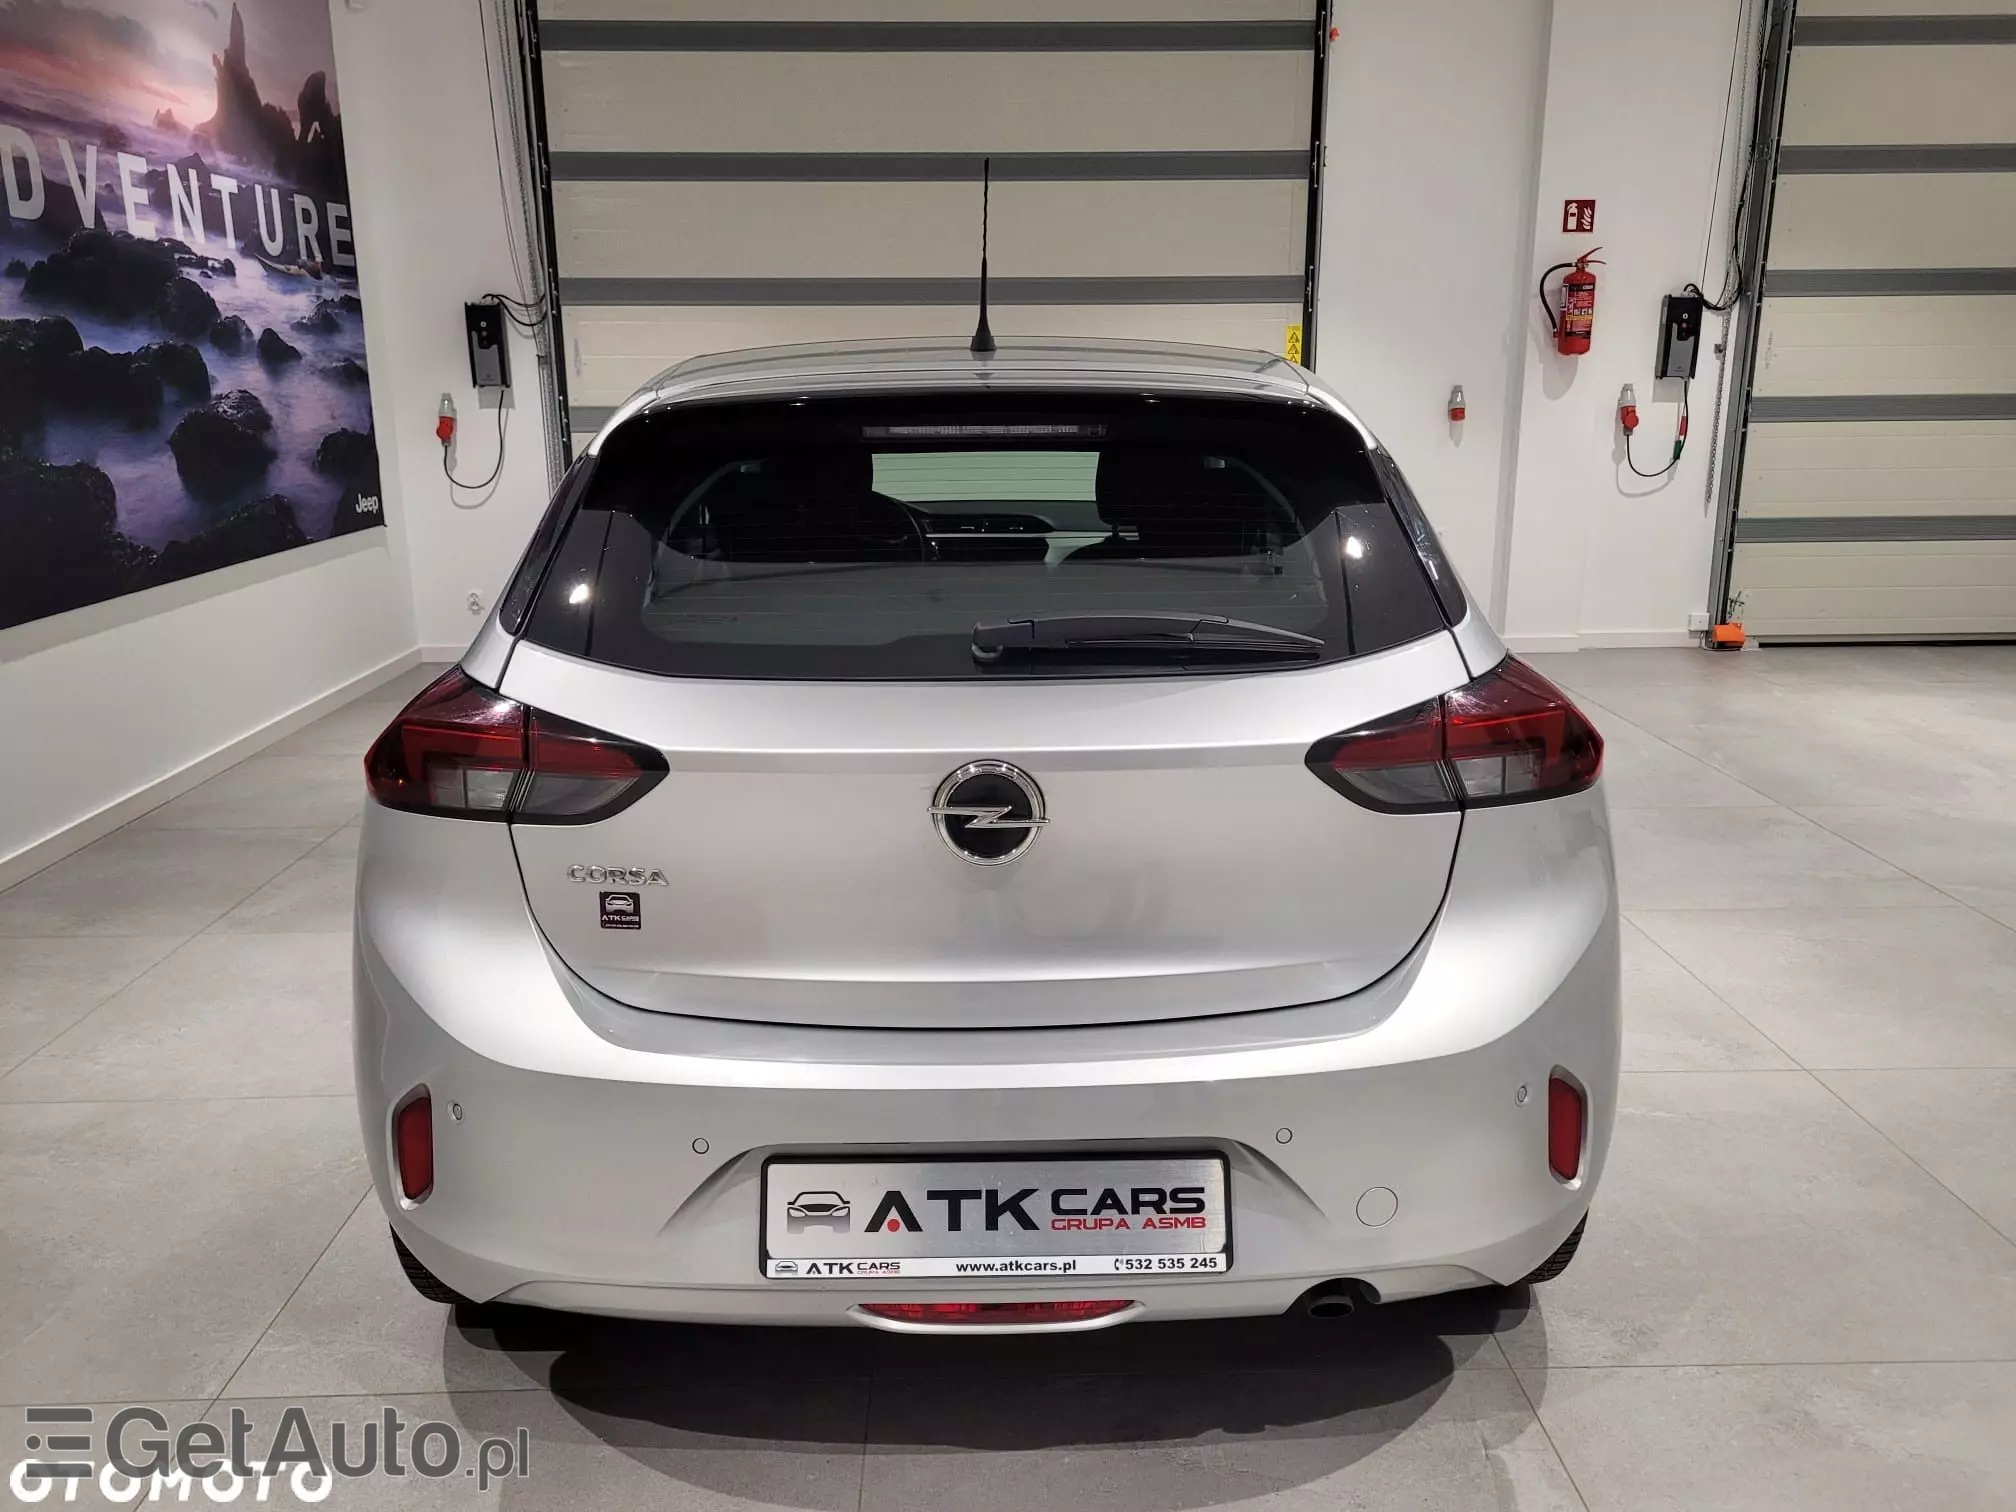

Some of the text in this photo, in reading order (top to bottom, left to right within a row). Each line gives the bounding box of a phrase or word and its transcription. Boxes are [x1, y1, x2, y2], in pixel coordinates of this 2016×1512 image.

[355, 493, 379, 515] Jeep
[567, 864, 670, 887] CORSA
[864, 1187, 1206, 1233] ATK CARS
[1051, 1216, 1207, 1231] GRUPA ASMB
[806, 1262, 901, 1275] ATK CARS
[956, 1259, 1077, 1274] www.atkcars.pl
[1125, 1257, 1218, 1270] 532 535 245
